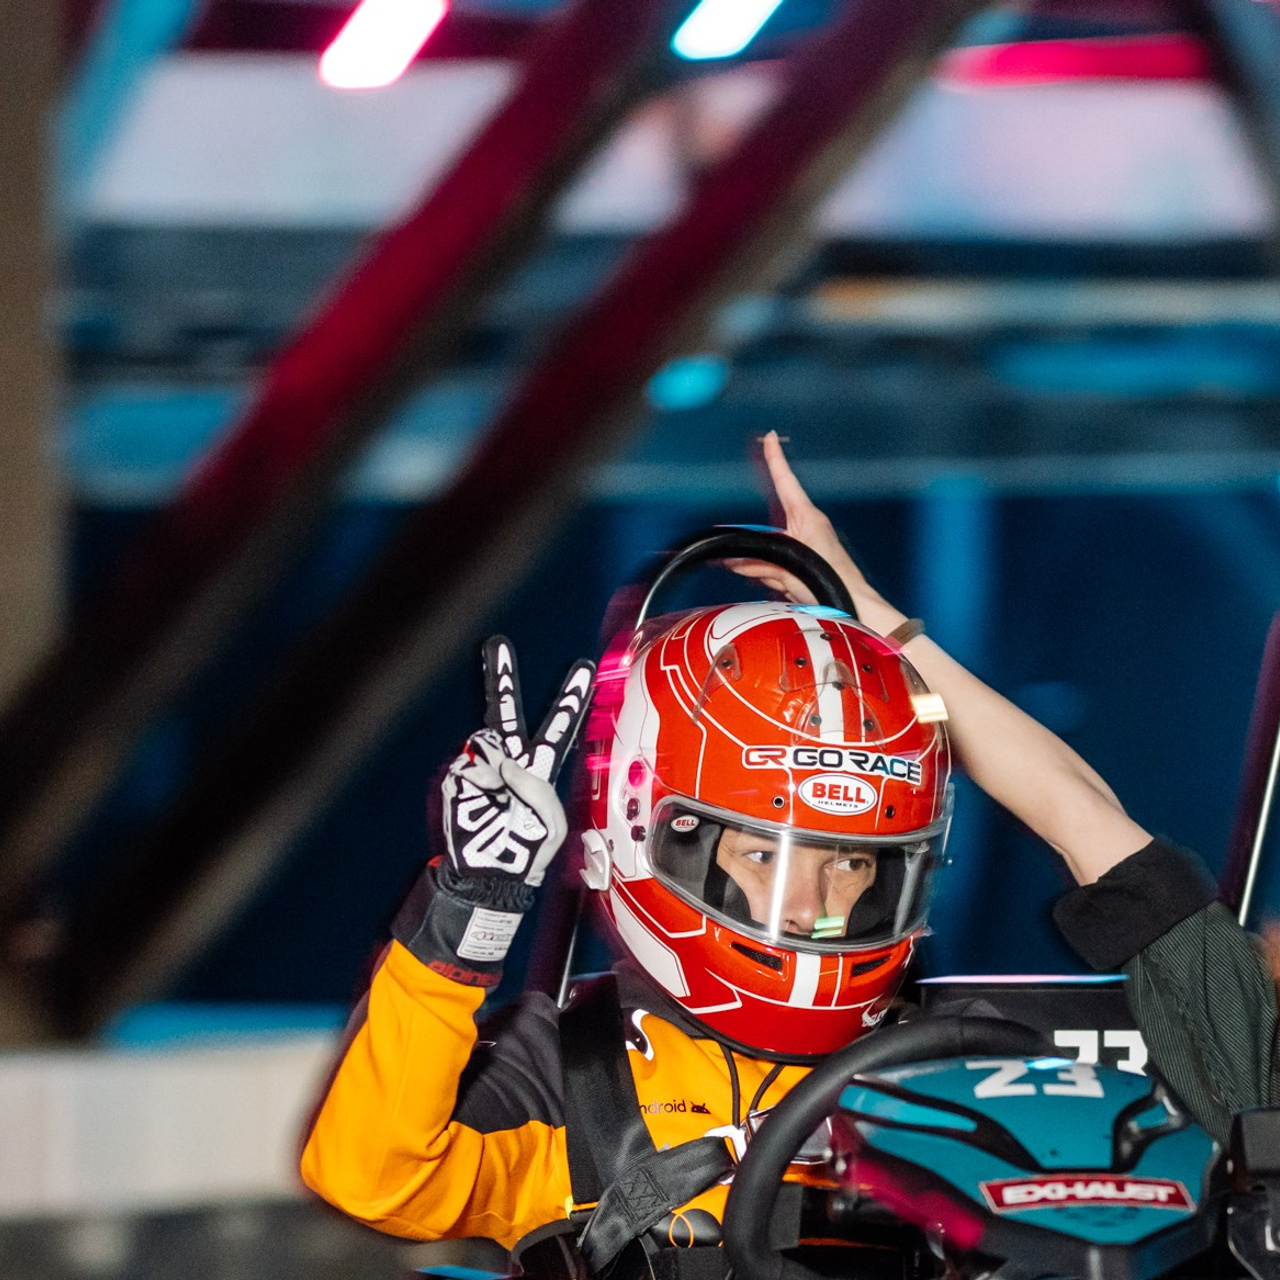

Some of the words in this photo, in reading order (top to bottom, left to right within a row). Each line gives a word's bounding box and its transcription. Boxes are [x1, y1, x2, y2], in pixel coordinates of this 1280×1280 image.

[792, 747, 844, 768] GO
[848, 751, 921, 782] RACE
[811, 782, 866, 804] BELL
[817, 800, 860, 809] HELMETS
[675, 819, 695, 827] BELL
[965, 1058, 1105, 1099] 23
[639, 1099, 688, 1114] ndroid
[1001, 1181, 1177, 1205] EXHAUST
